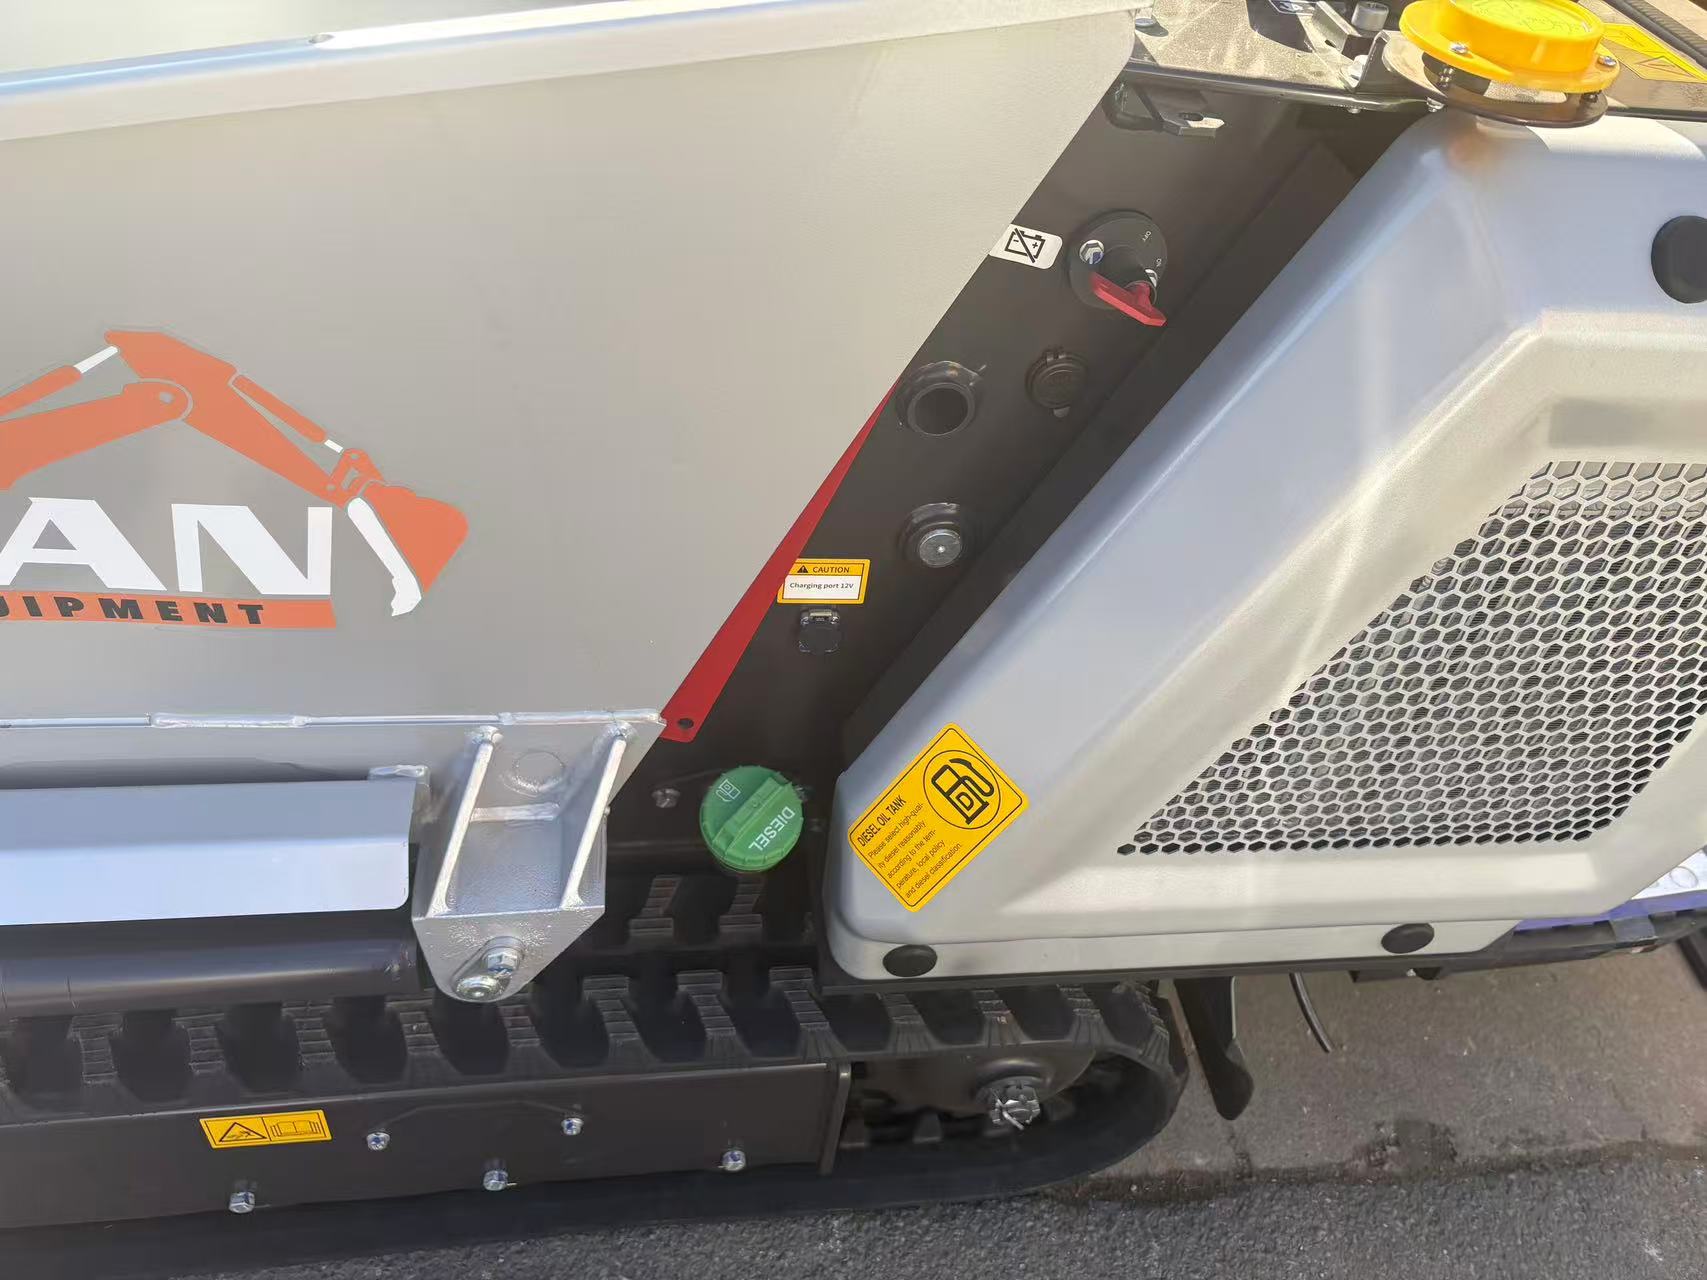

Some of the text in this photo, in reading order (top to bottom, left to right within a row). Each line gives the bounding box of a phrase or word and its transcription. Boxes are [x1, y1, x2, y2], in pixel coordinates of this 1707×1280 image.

[0, 497, 333, 595] AN
[955, 791, 974, 811] D
[748, 806, 795, 851] DIESEL
[857, 795, 907, 847] DIESEL OIL TANK
[867, 841, 886, 858] Please
[885, 826, 900, 842] select
[884, 846, 899, 862] diesel
[898, 820, 926, 847] reasonably
[888, 855, 912, 879] according
[915, 841, 925, 850] the
[916, 853, 930, 867] local
[929, 839, 946, 856] policy
[906, 885, 916, 898] and
[915, 872, 930, 888] diesel
